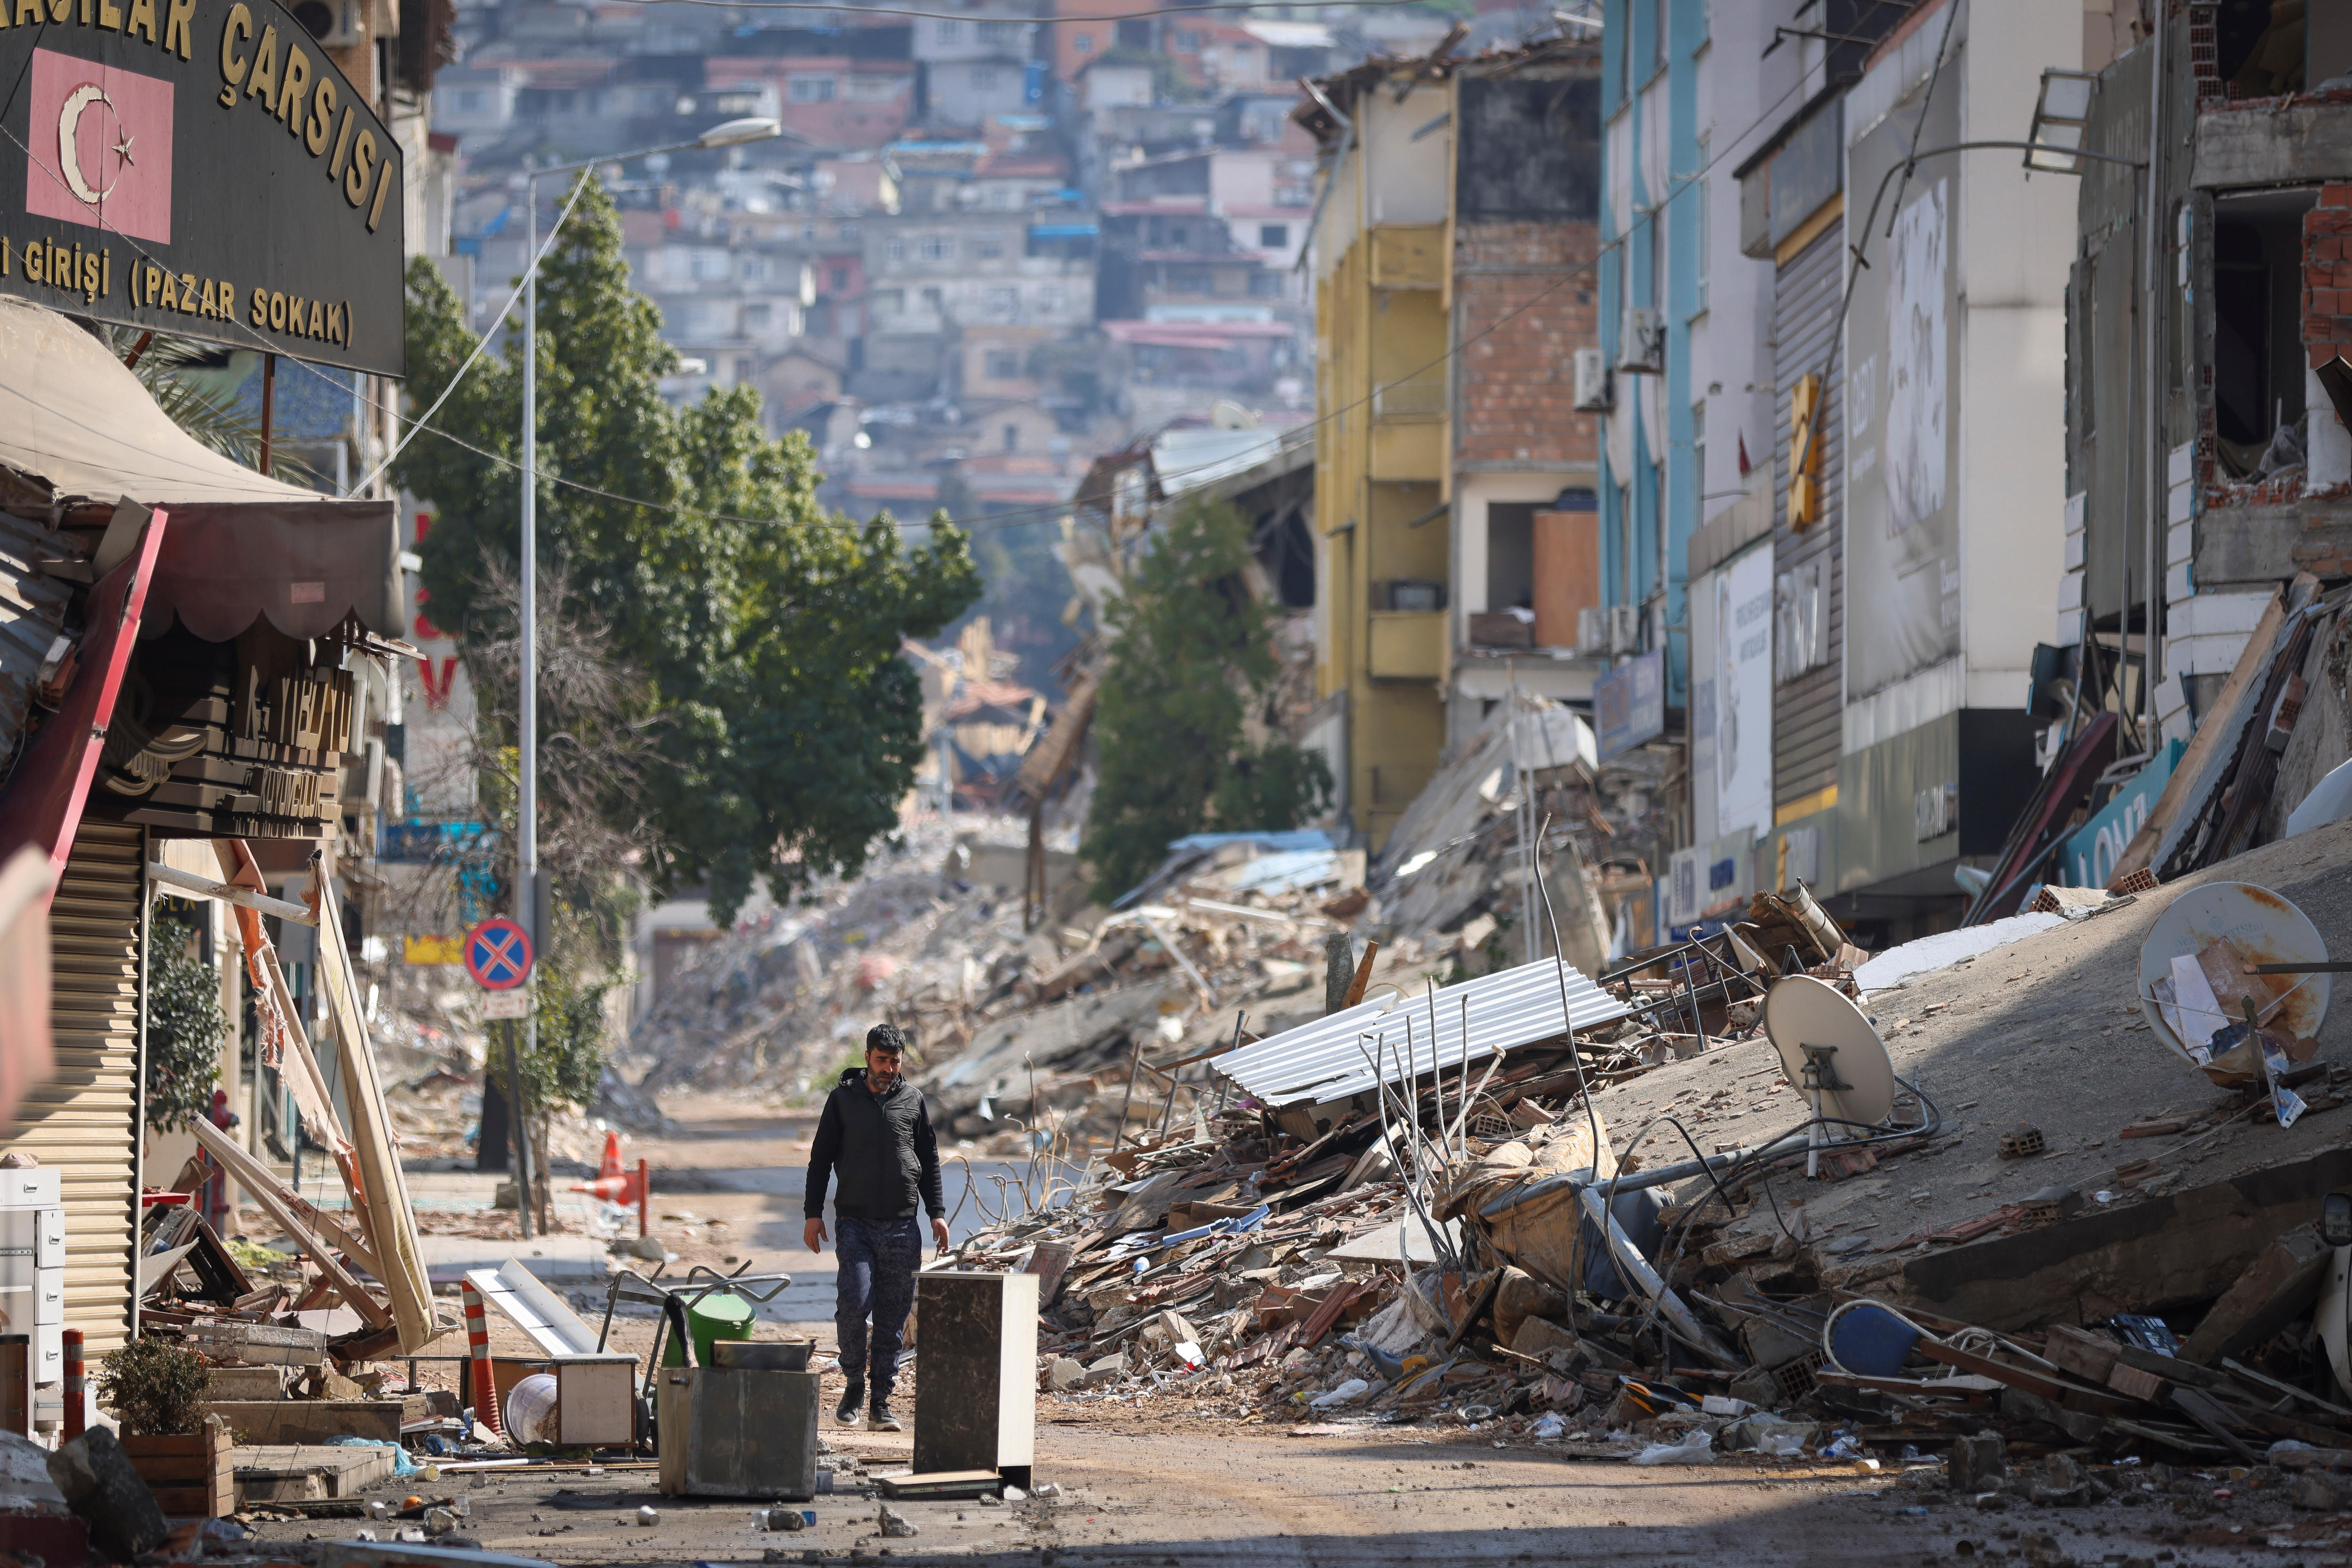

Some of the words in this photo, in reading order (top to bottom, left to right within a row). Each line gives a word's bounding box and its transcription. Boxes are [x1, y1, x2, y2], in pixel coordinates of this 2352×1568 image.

[221, 4, 392, 233] ÇARSISI
[25, 237, 109, 303] GİRİŞİ
[130, 259, 235, 321] (PAZAR
[251, 287, 353, 349] SOKAK)
